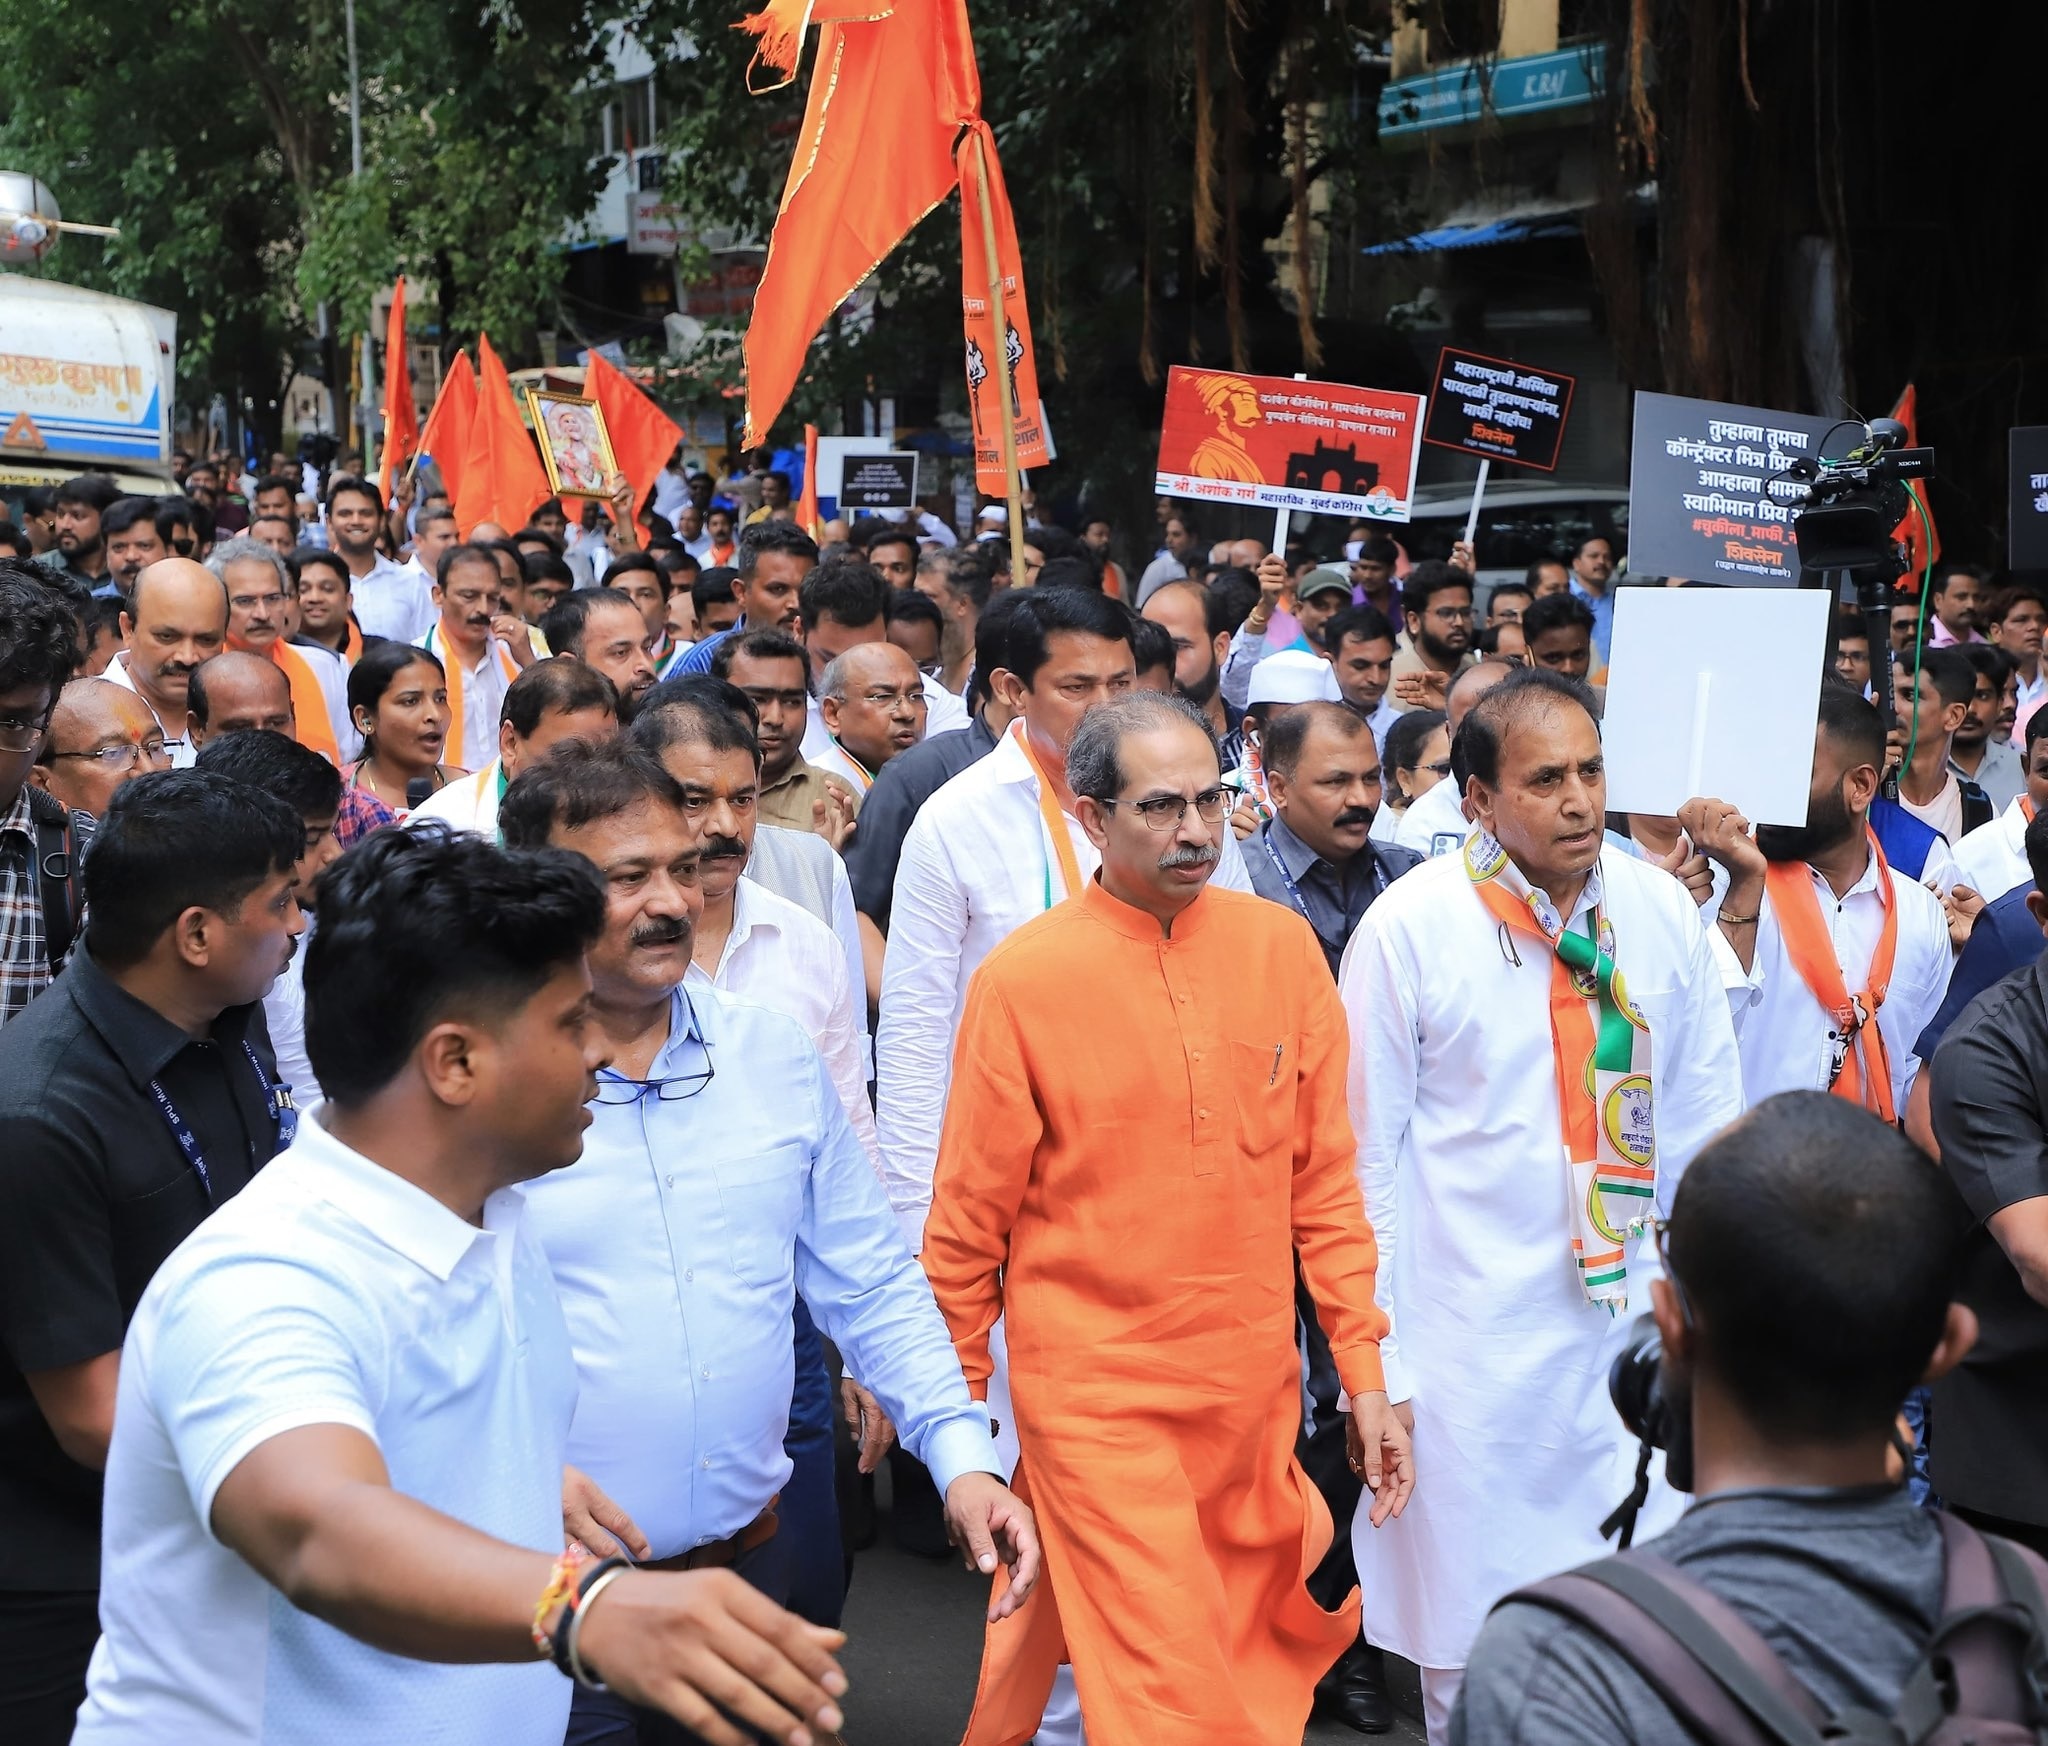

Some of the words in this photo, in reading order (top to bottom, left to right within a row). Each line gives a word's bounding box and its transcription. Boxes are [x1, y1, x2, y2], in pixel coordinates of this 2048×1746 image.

[1442, 378, 1489, 400] पायदळी
[1454, 361, 1516, 386] महाराष्ट्राची
[1515, 375, 1559, 397] अस्मिता
[1463, 402, 1494, 420] माफी
[1493, 410, 1533, 430] नाहीच!
[1708, 419, 1764, 443] तुम्हाला
[1766, 428, 1809, 450] तुमचा
[1735, 446, 1766, 469] मित्र
[1698, 470, 1762, 494] आम्हाला
[1236, 486, 1256, 500] गर्ग
[1310, 495, 1330, 510] मुंबई
[1683, 493, 1756, 519] स्वाभिमान
[1757, 499, 1788, 523] प्रिय
[1724, 541, 1783, 566] शिवसेना
[251, 1055, 270, 1091] Mumbai
[164, 1100, 180, 1125] SPU,
